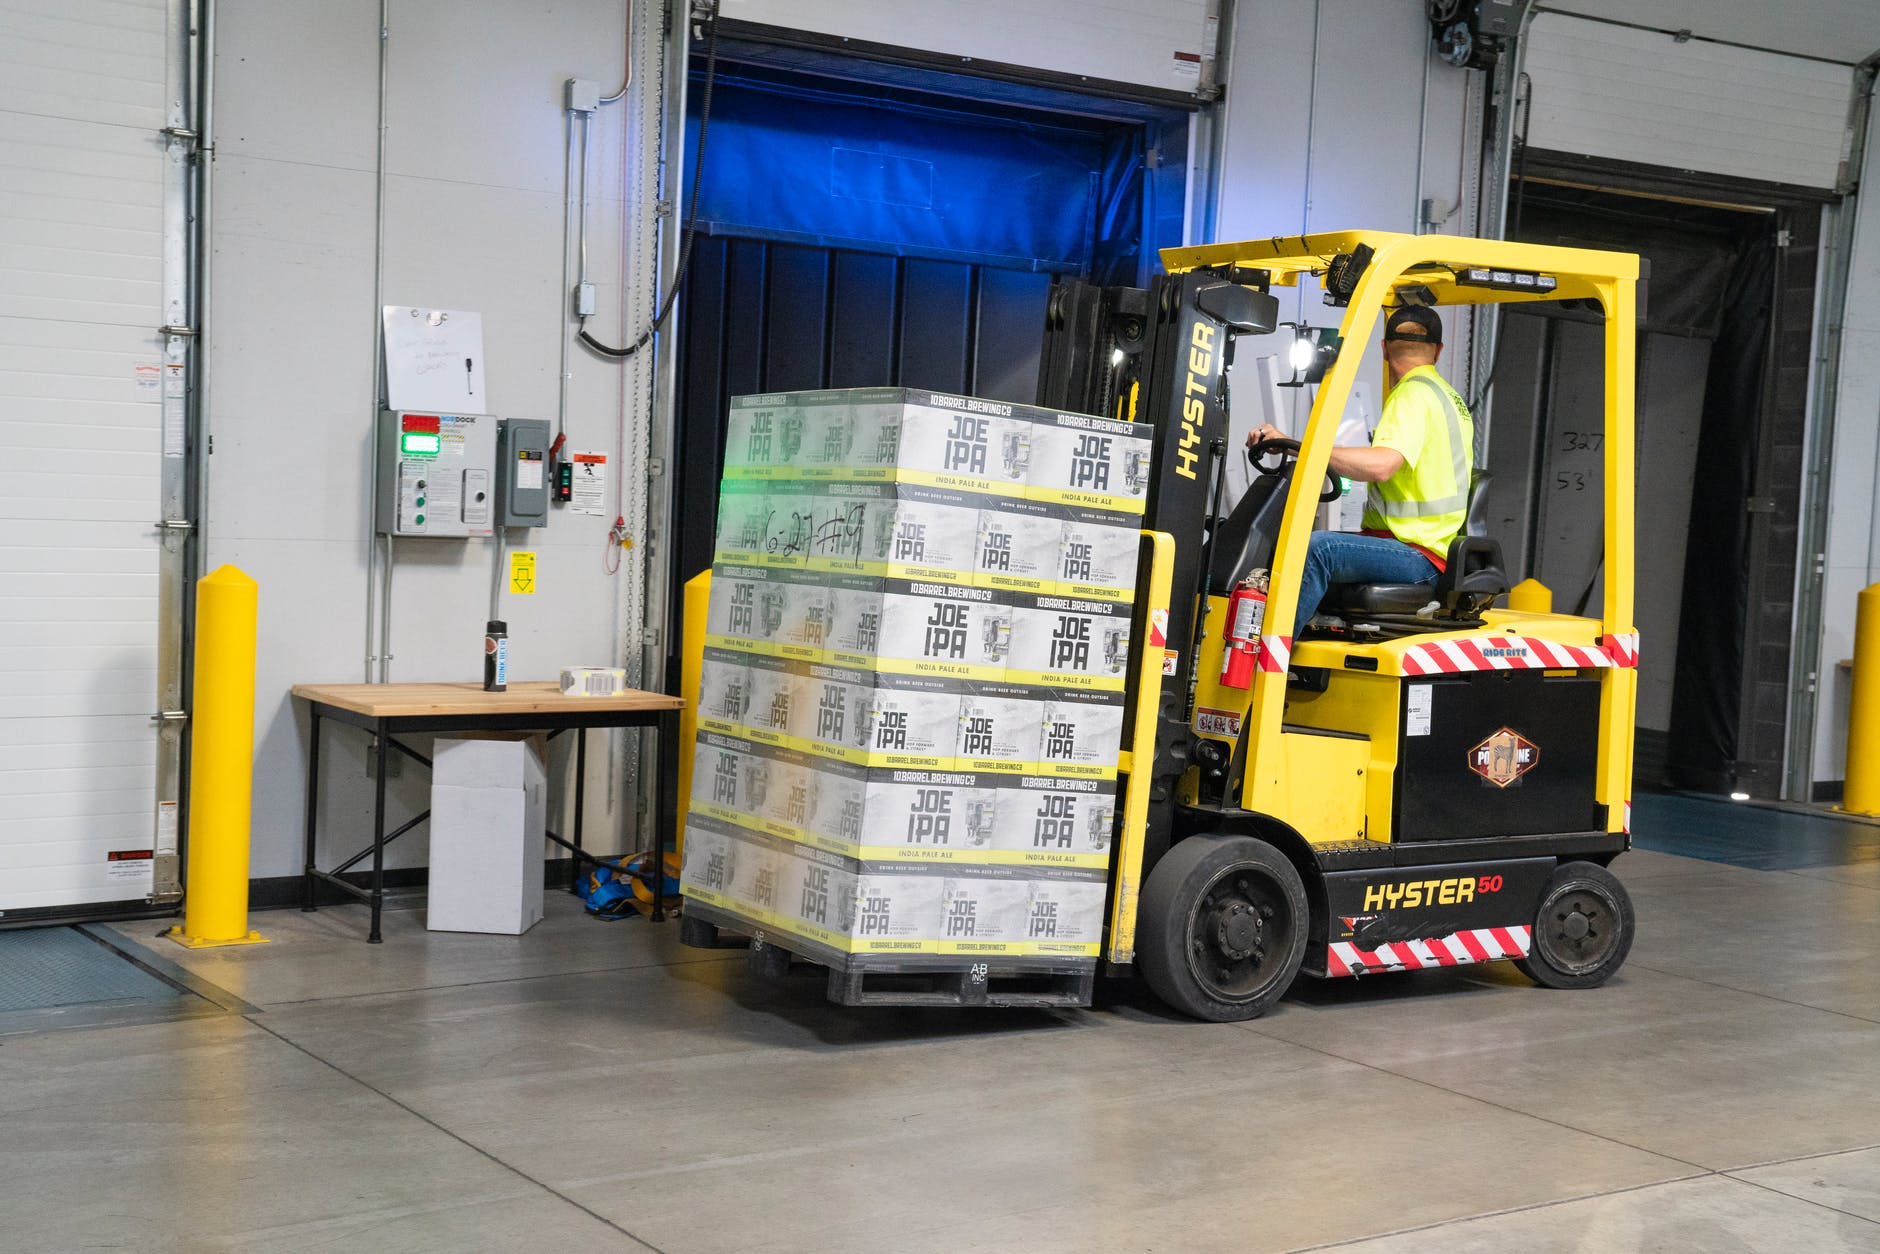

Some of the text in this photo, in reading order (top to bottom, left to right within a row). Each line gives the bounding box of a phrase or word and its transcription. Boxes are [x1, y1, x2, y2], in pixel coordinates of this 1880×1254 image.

[1176, 322, 1214, 480] HYSTER
[751, 412, 773, 433] JOE
[948, 416, 989, 442] JOE
[826, 426, 843, 442] JOE
[878, 425, 898, 442] JOE
[1562, 432, 1604, 451] 327
[748, 435, 771, 462] IPA
[824, 442, 842, 462] IPA
[876, 443, 897, 463] IPA
[944, 440, 986, 474] IPA
[1074, 435, 1112, 460] JOE
[936, 476, 990, 489] INDIA PALE ALE
[1070, 458, 1110, 490] IPA
[1062, 493, 1081, 502] INDIA
[898, 522, 926, 541] JOE
[984, 532, 1012, 550] JOE
[895, 540, 925, 562] IPA
[982, 548, 1010, 571] IPA
[1065, 543, 1092, 560] JOE
[1063, 559, 1091, 581] IPA
[731, 583, 754, 605] JOE
[729, 605, 752, 634] IPA
[806, 607, 823, 622] JOE
[859, 613, 877, 630] JOE
[928, 603, 970, 628] JOE
[804, 620, 822, 644] IPA
[1053, 616, 1092, 640] JOE
[857, 630, 875, 651] IPA
[924, 627, 967, 659] IPA
[1050, 640, 1090, 670] IPA
[1483, 648, 1527, 657] RIDE RITE
[916, 664, 936, 672] INDIA
[1063, 676, 1079, 684] PALE
[725, 684, 741, 700] JOE
[772, 693, 789, 710] JOE
[820, 684, 846, 710] JOE
[723, 699, 739, 720] IPA
[770, 709, 787, 730] IPA
[879, 711, 908, 728] JOE
[817, 708, 844, 741] IPA
[966, 717, 993, 734] JOE
[1049, 723, 1075, 739] JOE
[876, 728, 906, 750] IPA
[963, 734, 991, 755] IPA
[1046, 738, 1073, 760] IPA
[826, 746, 837, 754] PALE
[716, 752, 738, 777] JOE
[713, 774, 736, 806] IPA
[790, 786, 806, 803] JOE
[842, 800, 860, 818] JOE
[911, 789, 953, 813] JOE
[1038, 795, 1076, 818] JOE
[787, 801, 805, 824] IPA
[840, 817, 858, 840] IPA
[907, 814, 950, 844] IPA
[1034, 818, 1074, 848] IPA
[708, 853, 724, 870] JOE
[706, 869, 723, 890] IPA
[756, 868, 773, 886] JOE
[804, 865, 829, 893] JOE
[754, 884, 772, 907] IPA
[1363, 875, 1503, 912] HYSTER 50
[801, 889, 827, 924] IPA
[862, 897, 890, 913] JOE
[950, 900, 977, 916] JOE
[1032, 902, 1058, 918] JOE
[860, 914, 890, 935] IPA
[947, 917, 975, 937] IPA
[1029, 918, 1056, 938] IPA
[971, 974, 985, 982] INC
